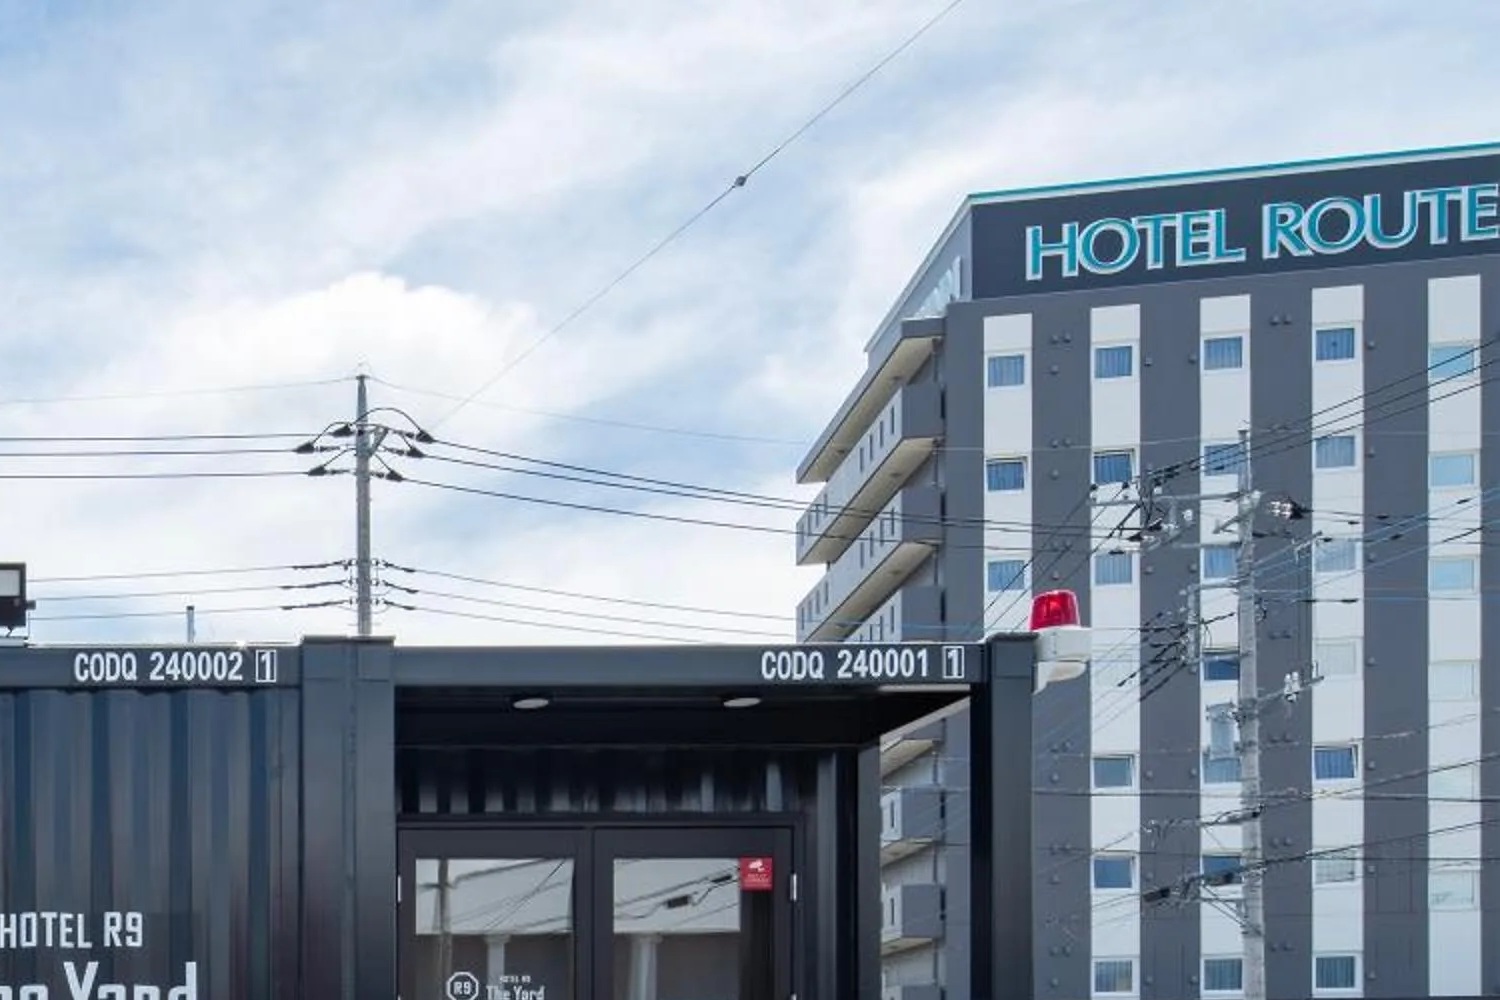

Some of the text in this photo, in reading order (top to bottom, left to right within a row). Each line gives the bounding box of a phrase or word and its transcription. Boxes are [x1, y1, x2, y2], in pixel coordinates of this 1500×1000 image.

[1025, 183, 1500, 281] HOTEL ROUTE
[74, 651, 274, 682] CODQ 240002 1
[761, 647, 961, 680] CODQ 240001 1
[103, 912, 143, 947] R9
[513, 985, 545, 1000] Yard
